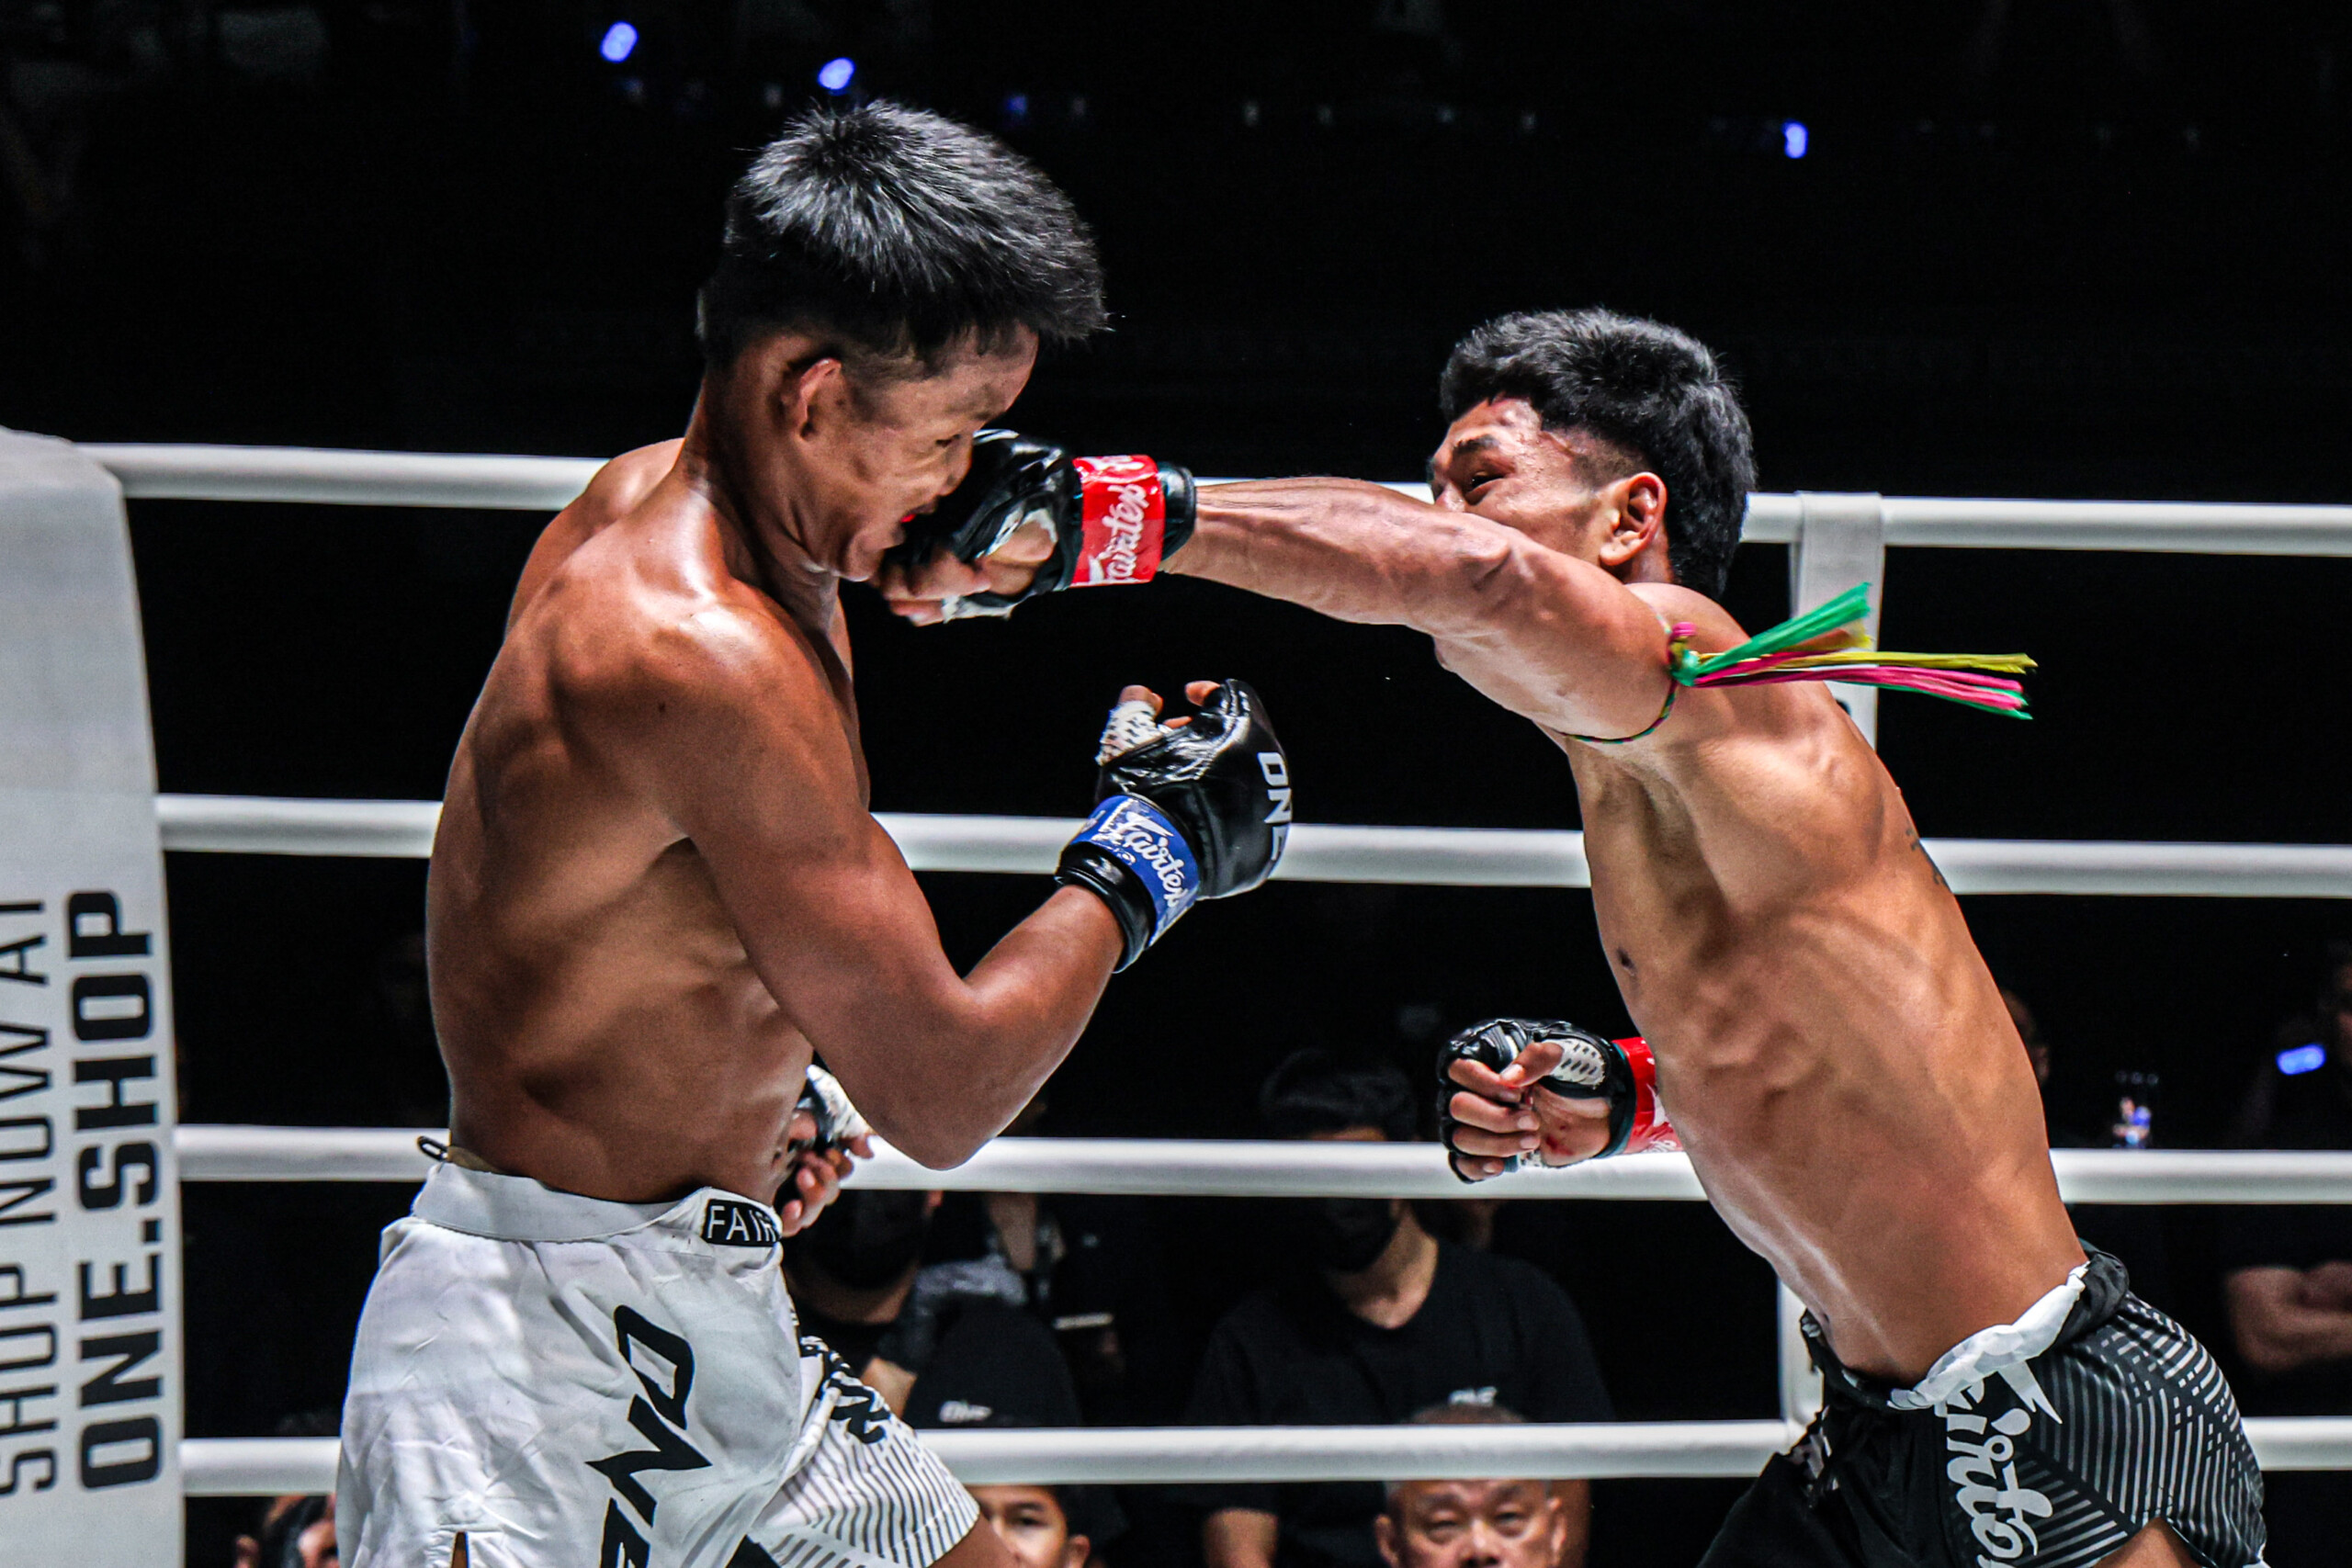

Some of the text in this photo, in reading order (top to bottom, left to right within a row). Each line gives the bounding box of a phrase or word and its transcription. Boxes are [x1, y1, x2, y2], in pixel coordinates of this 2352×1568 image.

[1117, 811, 1189, 908] Fairtex
[0, 1022, 55, 1227] NOW
[66, 890, 162, 1490] ONE.SHOP
[0, 1264, 57, 1496] SHOP
